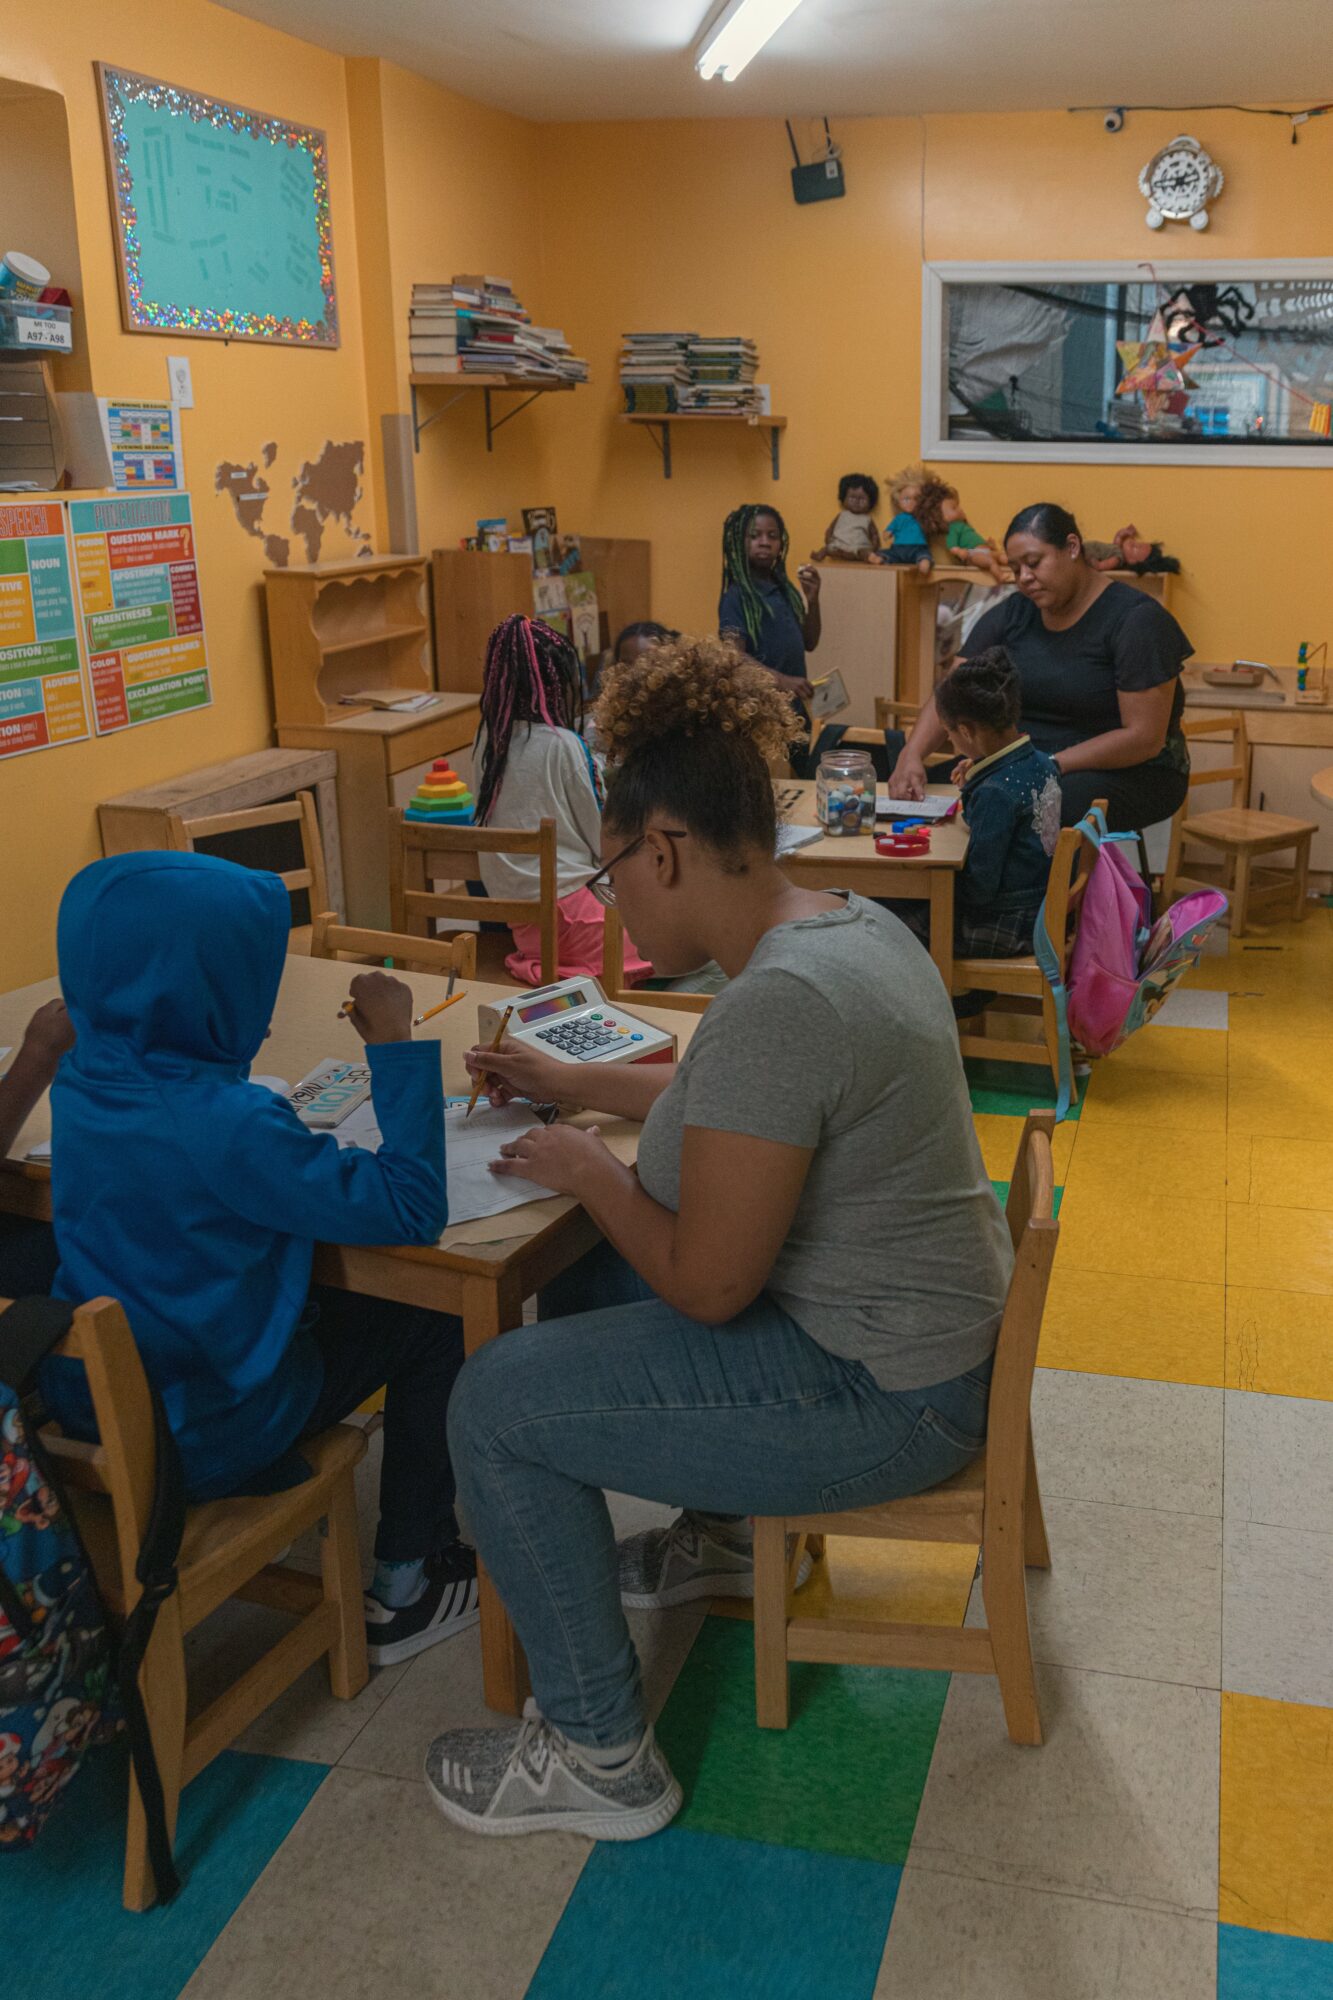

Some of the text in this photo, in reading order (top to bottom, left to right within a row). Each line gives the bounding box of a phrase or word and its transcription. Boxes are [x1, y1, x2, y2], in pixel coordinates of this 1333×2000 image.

[27, 331, 43, 342] A97
[49, 334, 65, 344] A98
[94, 498, 172, 529] PUNCTUATION
[0, 507, 48, 536] SPEECH
[110, 532, 153, 545] QUESTION
[154, 529, 180, 540] MARK
[31, 558, 60, 570] NOUN
[113, 566, 164, 580] APOSTROPHE
[92, 607, 152, 626] PARENTHESES
[127, 647, 170, 662] QUOTATION
[91, 657, 116, 669] COLON
[45, 675, 79, 688] ADVERB
[127, 673, 206, 699] EXCLAMATION POINT
[306, 1069, 371, 1113] BE YOU
